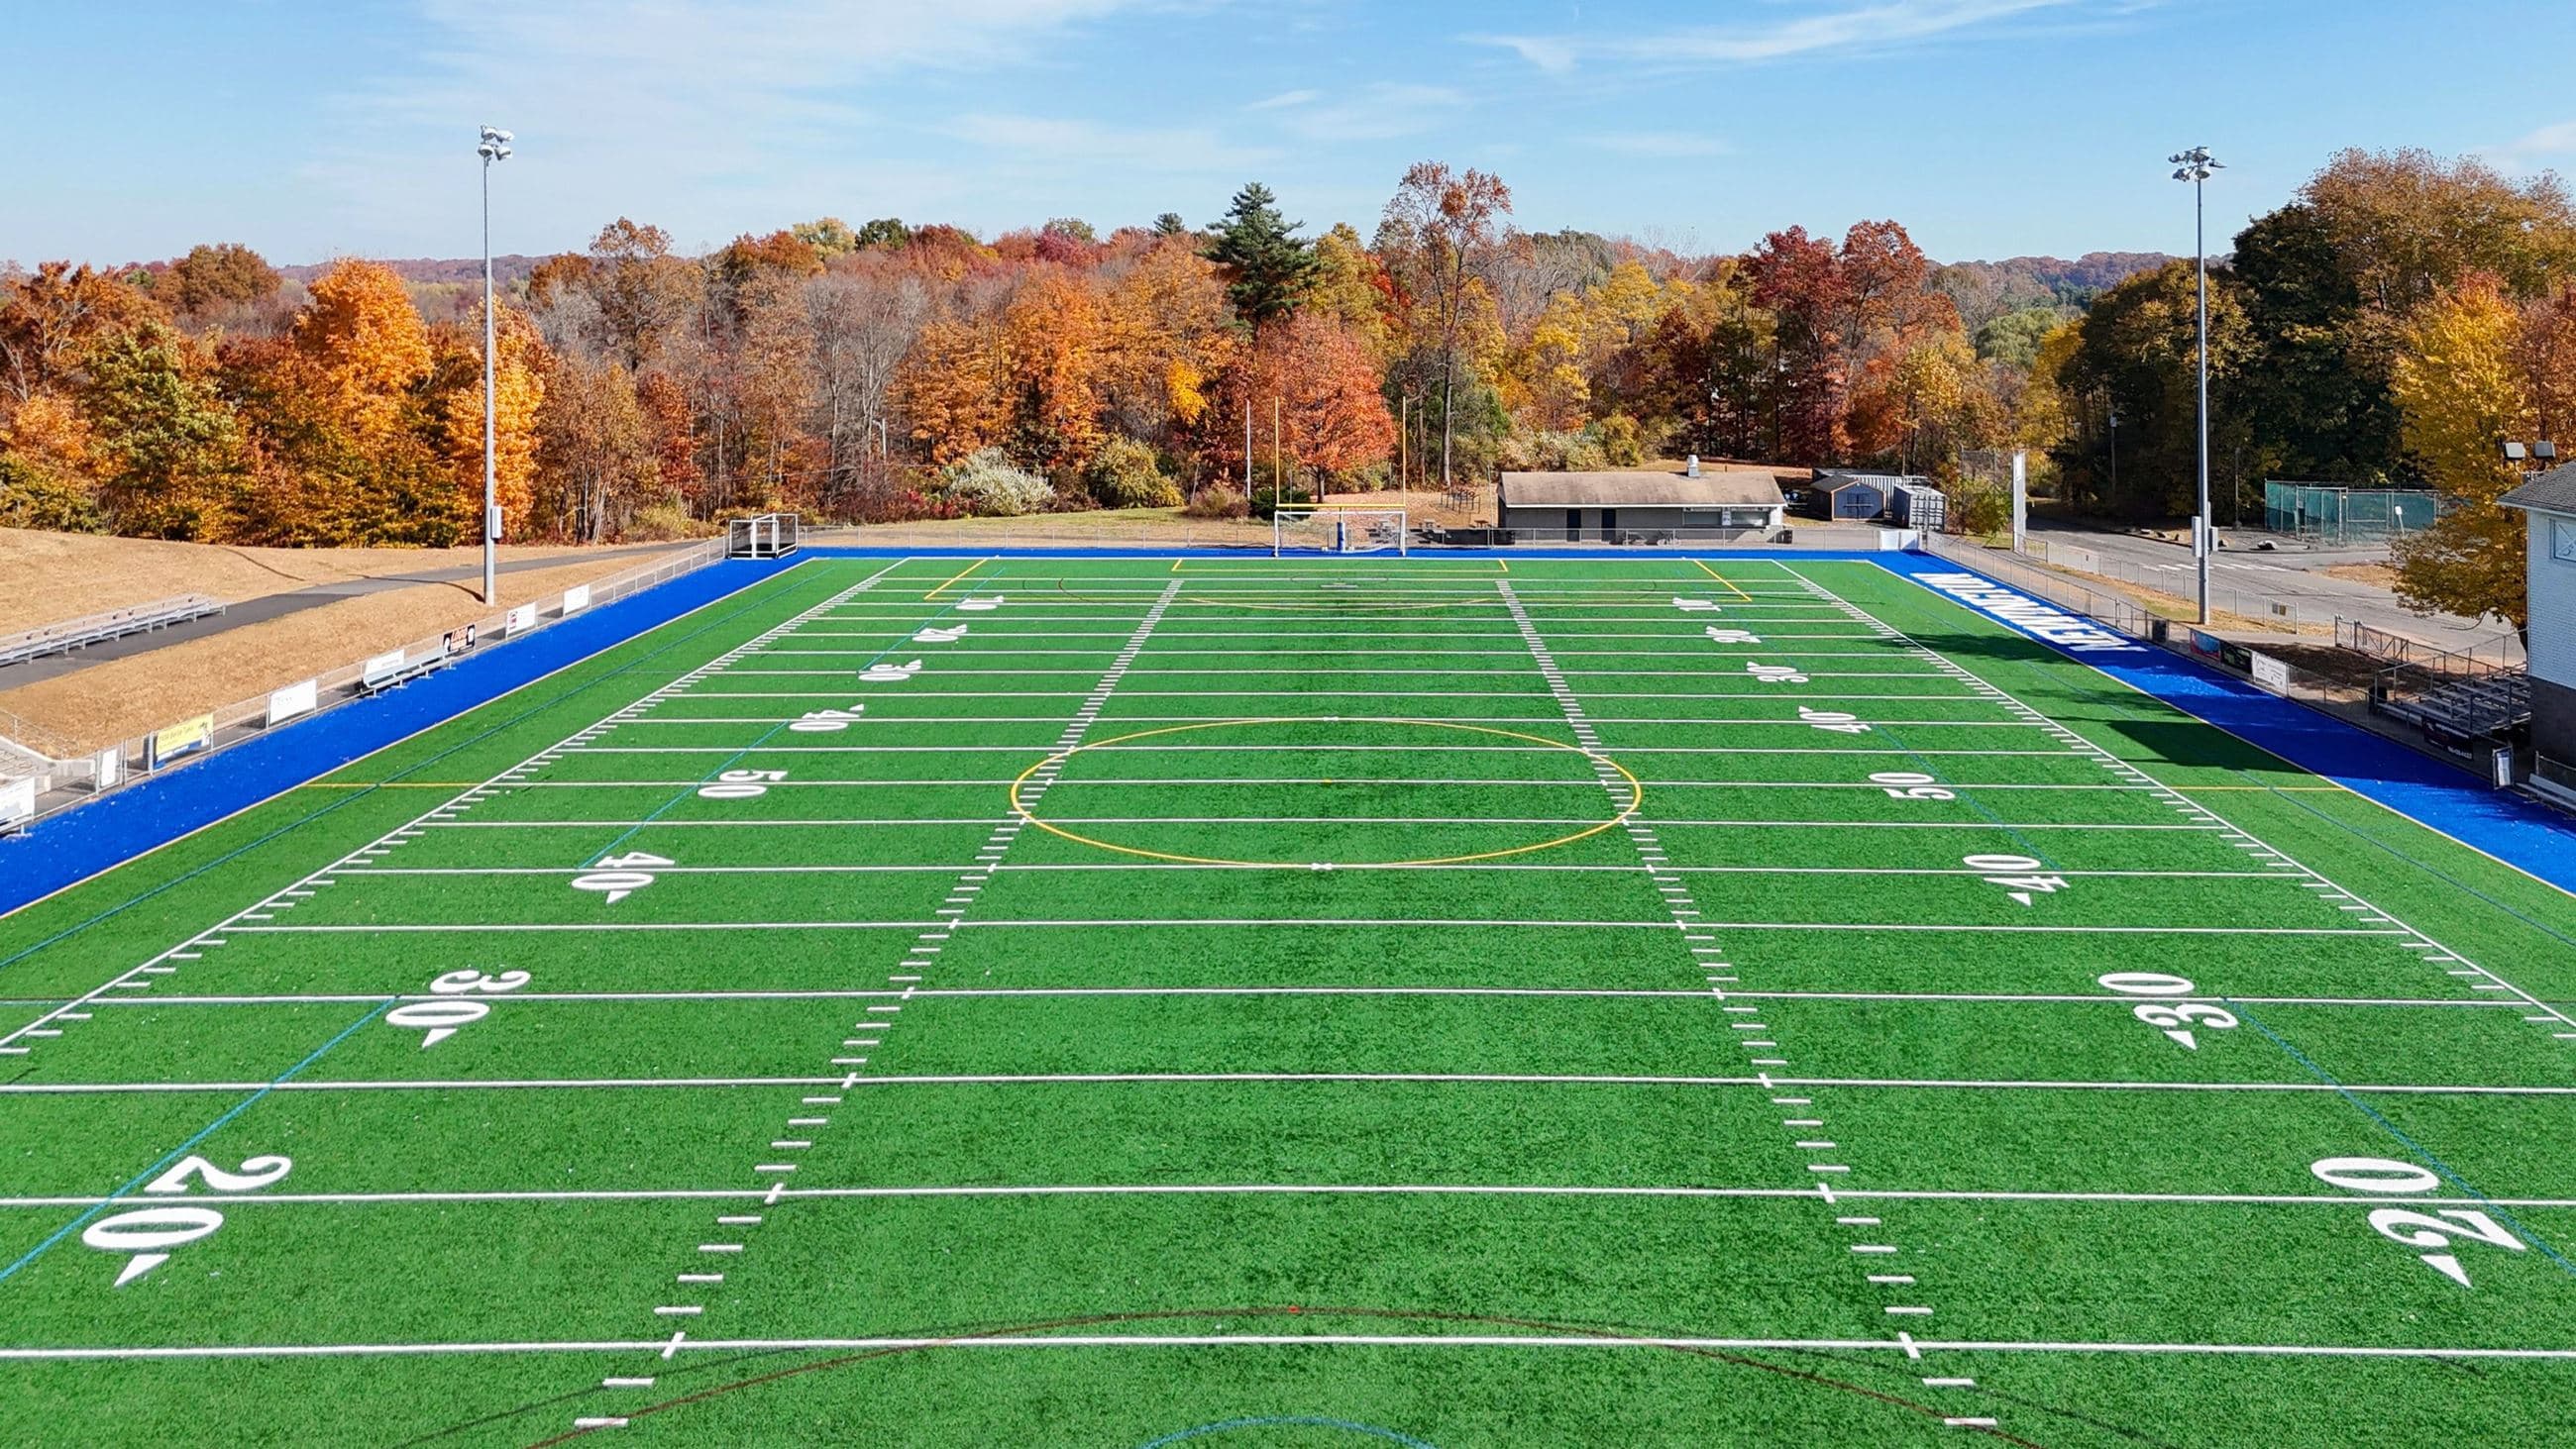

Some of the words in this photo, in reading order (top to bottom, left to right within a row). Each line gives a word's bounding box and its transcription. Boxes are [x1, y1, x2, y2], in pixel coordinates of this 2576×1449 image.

[955, 597, 1004, 610] 10
[1671, 599, 1722, 611] 10
[1909, 572, 2149, 653] NEWINGTON
[912, 627, 967, 642] 20
[1705, 629, 1762, 644] 20
[858, 664, 921, 681] 30
[1746, 665, 1809, 682] 30
[789, 709, 861, 731] 40
[1798, 711, 1872, 734] 40
[697, 769, 789, 798] 50
[1868, 773, 1956, 800] 50
[571, 851, 676, 890] 40
[1962, 854, 2071, 892] 40
[385, 969, 532, 1027] 30
[2097, 972, 2239, 1029] 30
[81, 1154, 291, 1249] 20
[2310, 1157, 2526, 1250] 20
